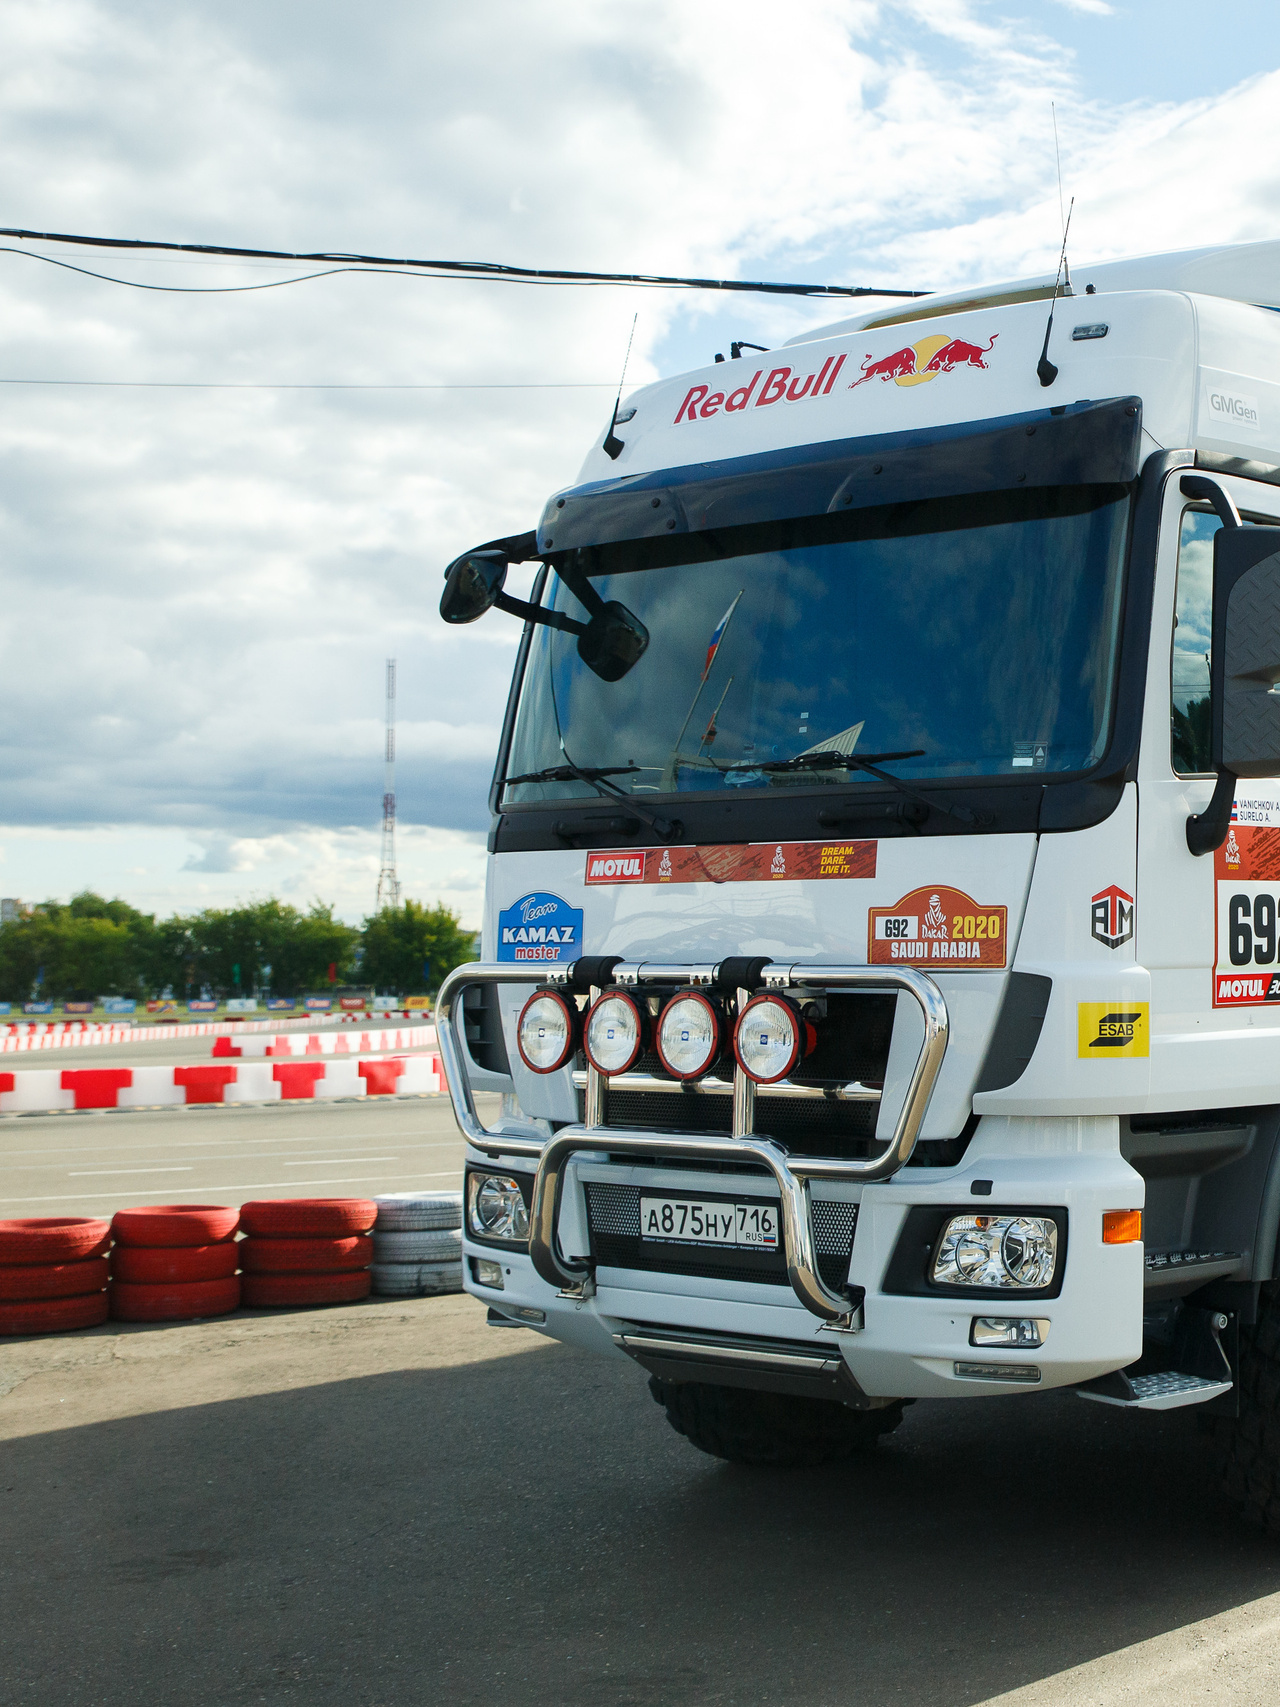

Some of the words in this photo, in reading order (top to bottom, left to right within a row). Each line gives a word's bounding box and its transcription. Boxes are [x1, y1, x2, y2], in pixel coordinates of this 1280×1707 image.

[673, 370, 763, 425] Red
[755, 353, 848, 408] Bull
[1210, 393, 1257, 420] GMGen
[1239, 799, 1275, 811] VANICHKOV
[1239, 810, 1264, 822] SURELO
[821, 846, 855, 856] DREAM.
[590, 858, 642, 878] MOTUL
[820, 856, 846, 865] DARE.
[820, 865, 839, 874] LIVE
[840, 865, 851, 874] IT.
[520, 897, 558, 924] Team
[502, 926, 575, 944] KAMAZ
[884, 918, 909, 938] 692
[952, 915, 1000, 939] 2020
[515, 944, 560, 961] master
[890, 941, 929, 958] SAUDI
[931, 941, 981, 958] ARABIA
[1218, 979, 1265, 998] MOTUL
[1098, 1022, 1135, 1037] ESAB
[647, 1203, 733, 1238] А875НУ
[737, 1207, 773, 1232] 716
[745, 1232, 763, 1242] RUS
